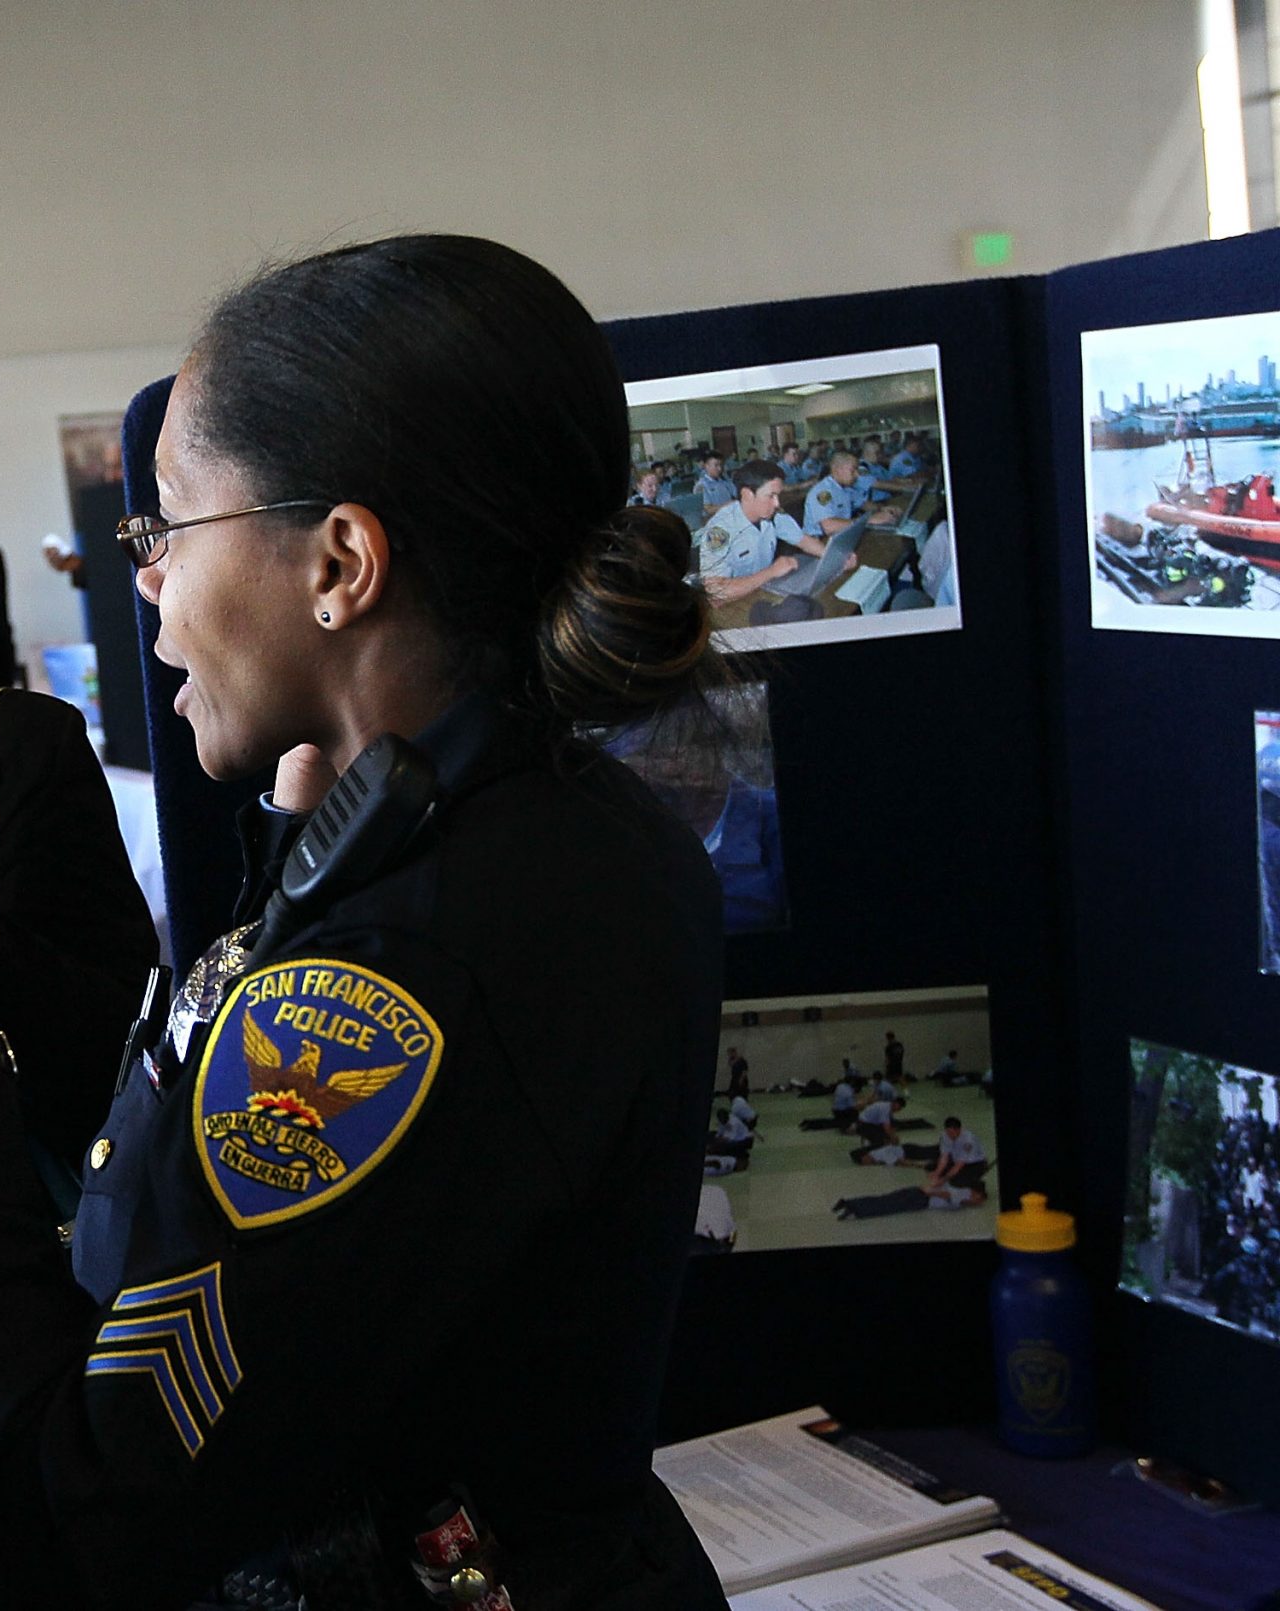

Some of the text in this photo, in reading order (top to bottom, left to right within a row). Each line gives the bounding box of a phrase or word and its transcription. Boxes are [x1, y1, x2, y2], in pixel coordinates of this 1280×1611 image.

[245, 969, 431, 1057] SAN FRANCISCO
[274, 1001, 377, 1051] POLICE
[224, 1145, 304, 1189] EN GUERRA
[285, 1130, 338, 1169] FIERRO
